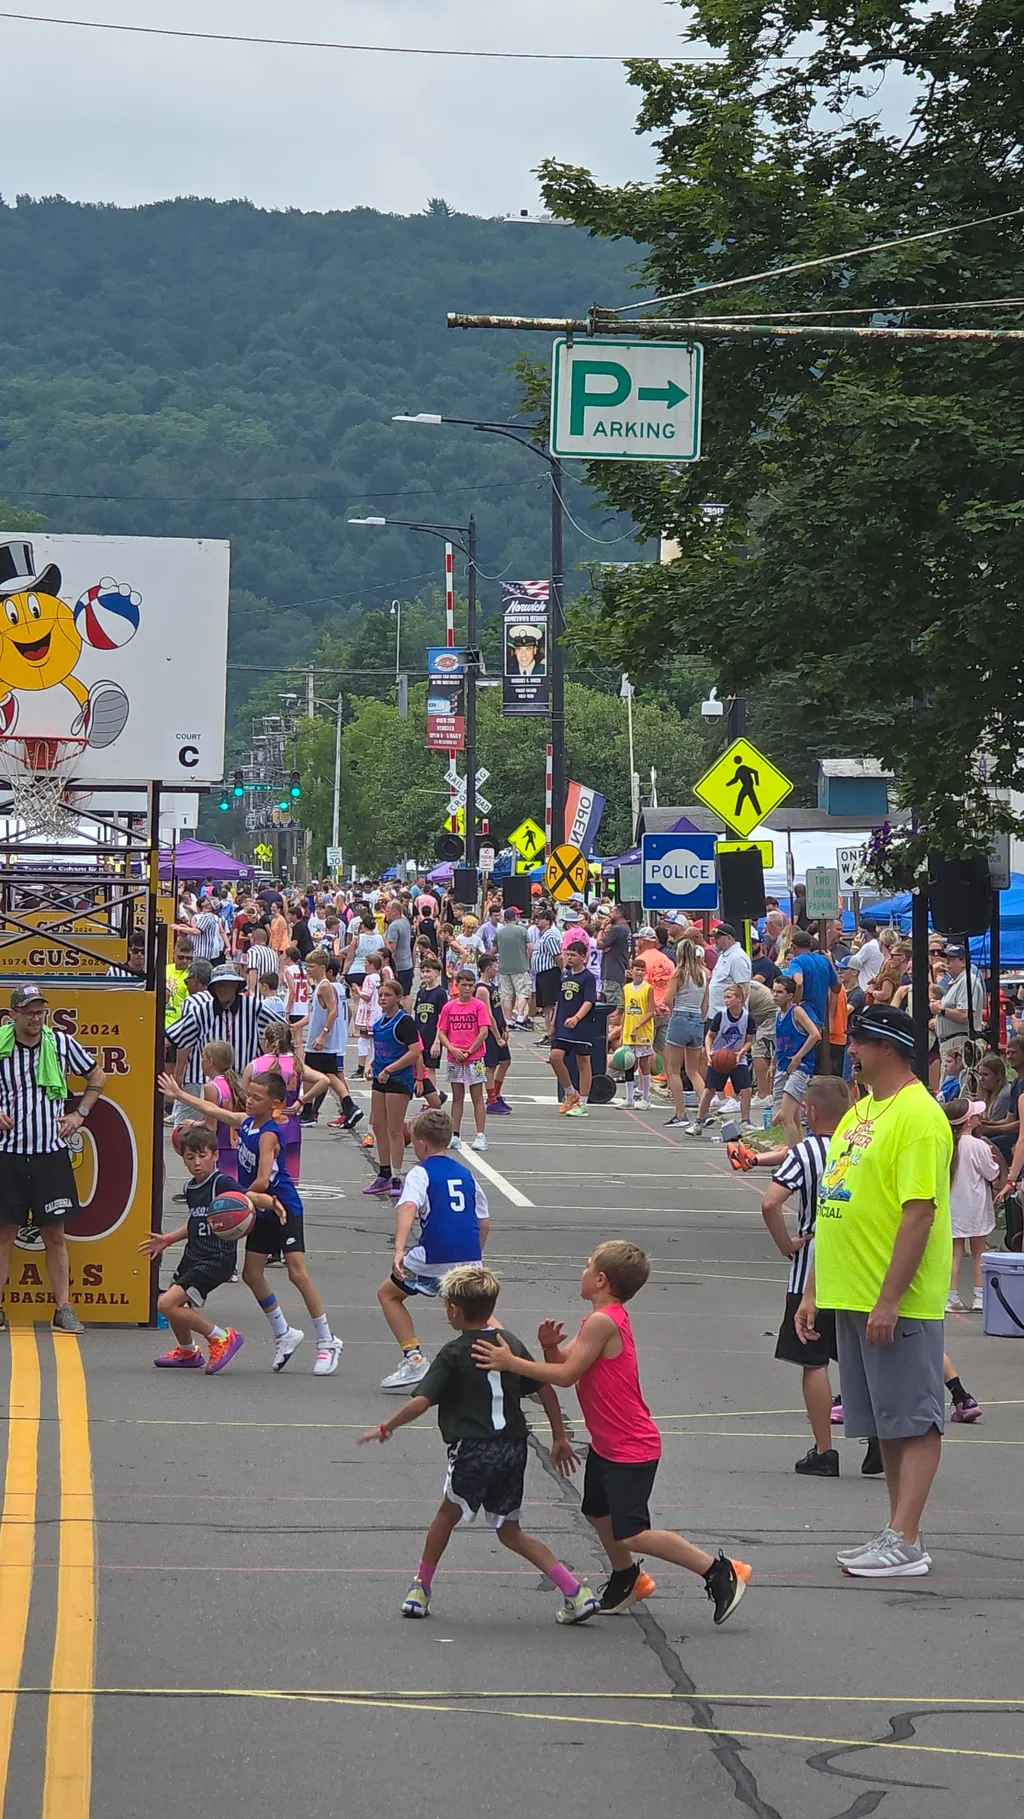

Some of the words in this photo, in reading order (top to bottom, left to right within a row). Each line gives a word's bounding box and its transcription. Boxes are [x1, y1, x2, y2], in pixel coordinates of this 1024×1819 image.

[505, 600, 547, 614] Norwich
[179, 745, 199, 768] C
[446, 772, 464, 790] RAIL
[549, 866, 558, 881] R
[575, 867, 584, 882] R
[651, 864, 710, 879] POLICE
[815, 876, 830, 886] TWO
[812, 889, 832, 899] HOUR
[808, 902, 837, 912] PARKING
[2, 958, 28, 966] 1974
[28, 949, 80, 968] GUS
[80, 1024, 120, 1036] 2024
[446, 1179, 466, 1213] 5
[486, 1369, 507, 1431] 1
